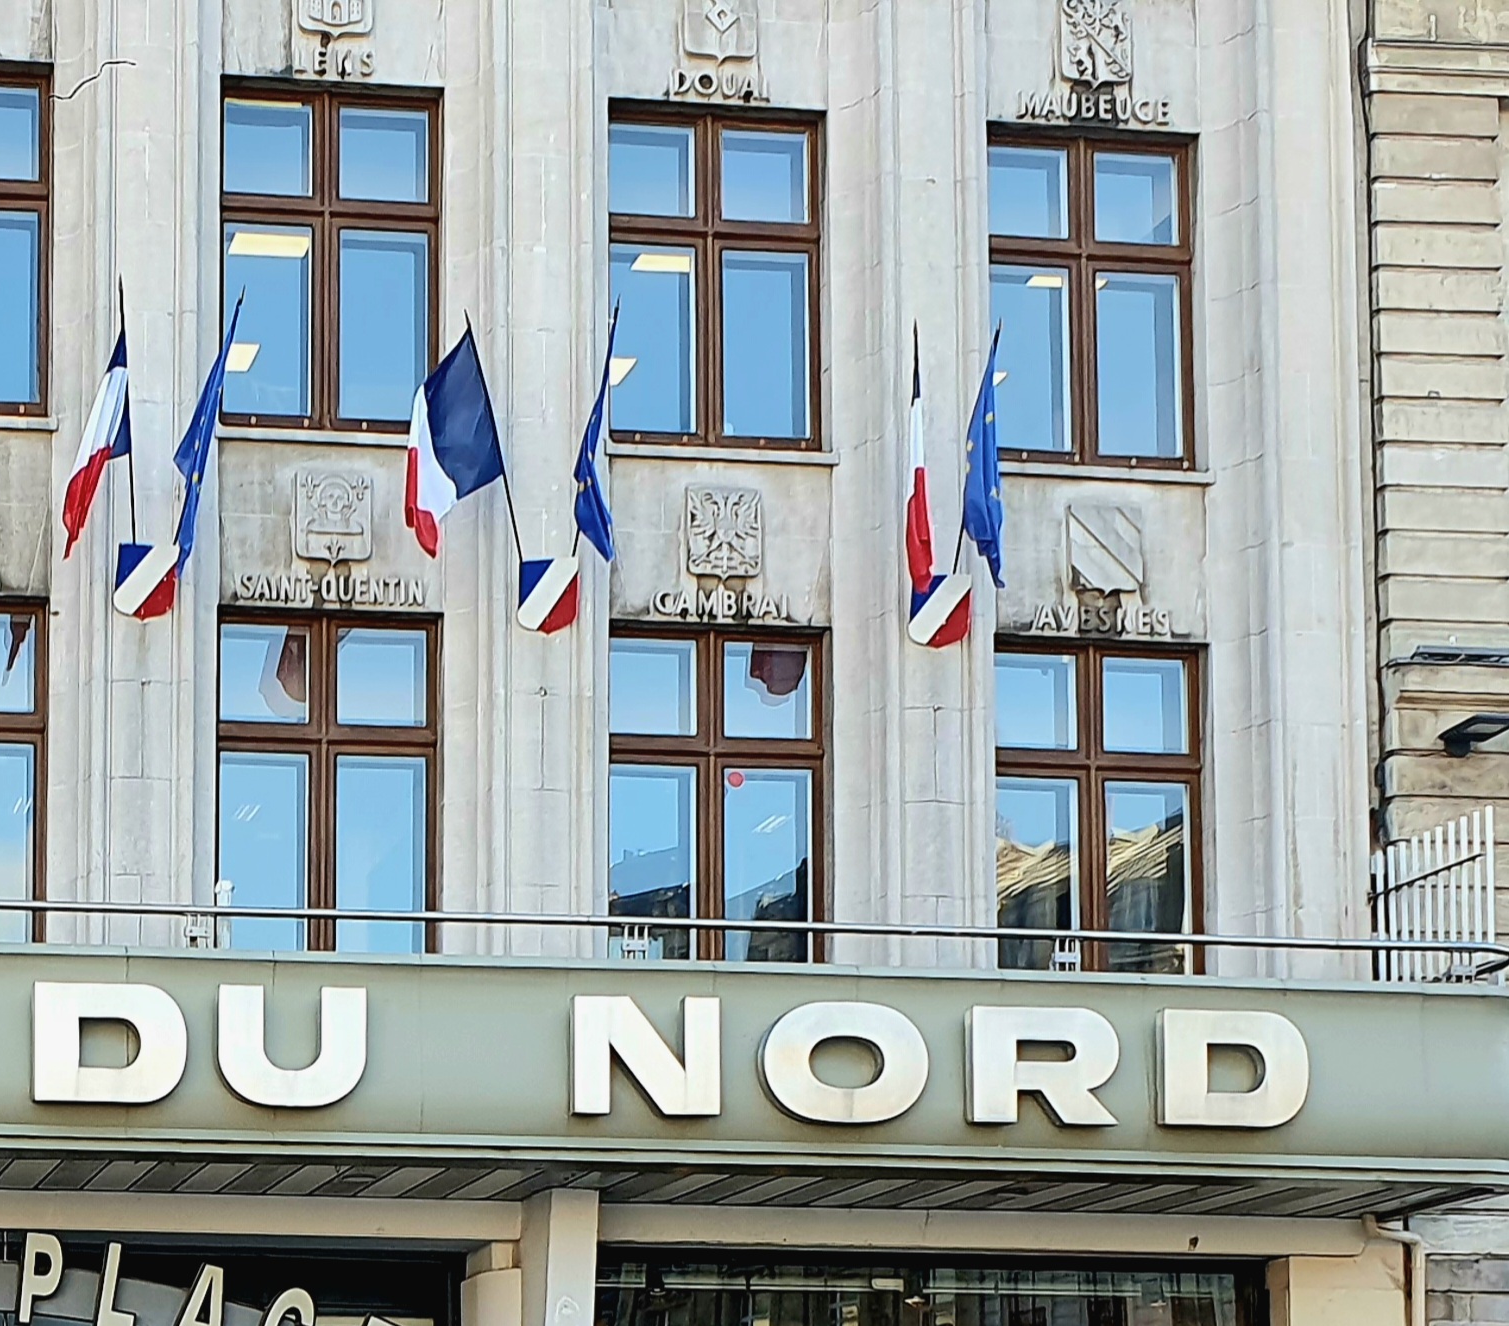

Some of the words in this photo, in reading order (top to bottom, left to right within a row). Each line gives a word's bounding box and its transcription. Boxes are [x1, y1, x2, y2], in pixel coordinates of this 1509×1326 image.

[293, 48, 375, 77] LENS
[673, 70, 771, 103] DOUAI
[1016, 91, 1171, 126] MAUBEUGE
[240, 574, 424, 606] SAINT-QUENTIN
[654, 589, 789, 619] CAMBRAI
[1035, 604, 1171, 636] AVESNES
[32, 980, 368, 1109] DU
[570, 994, 1311, 1129] NORD
